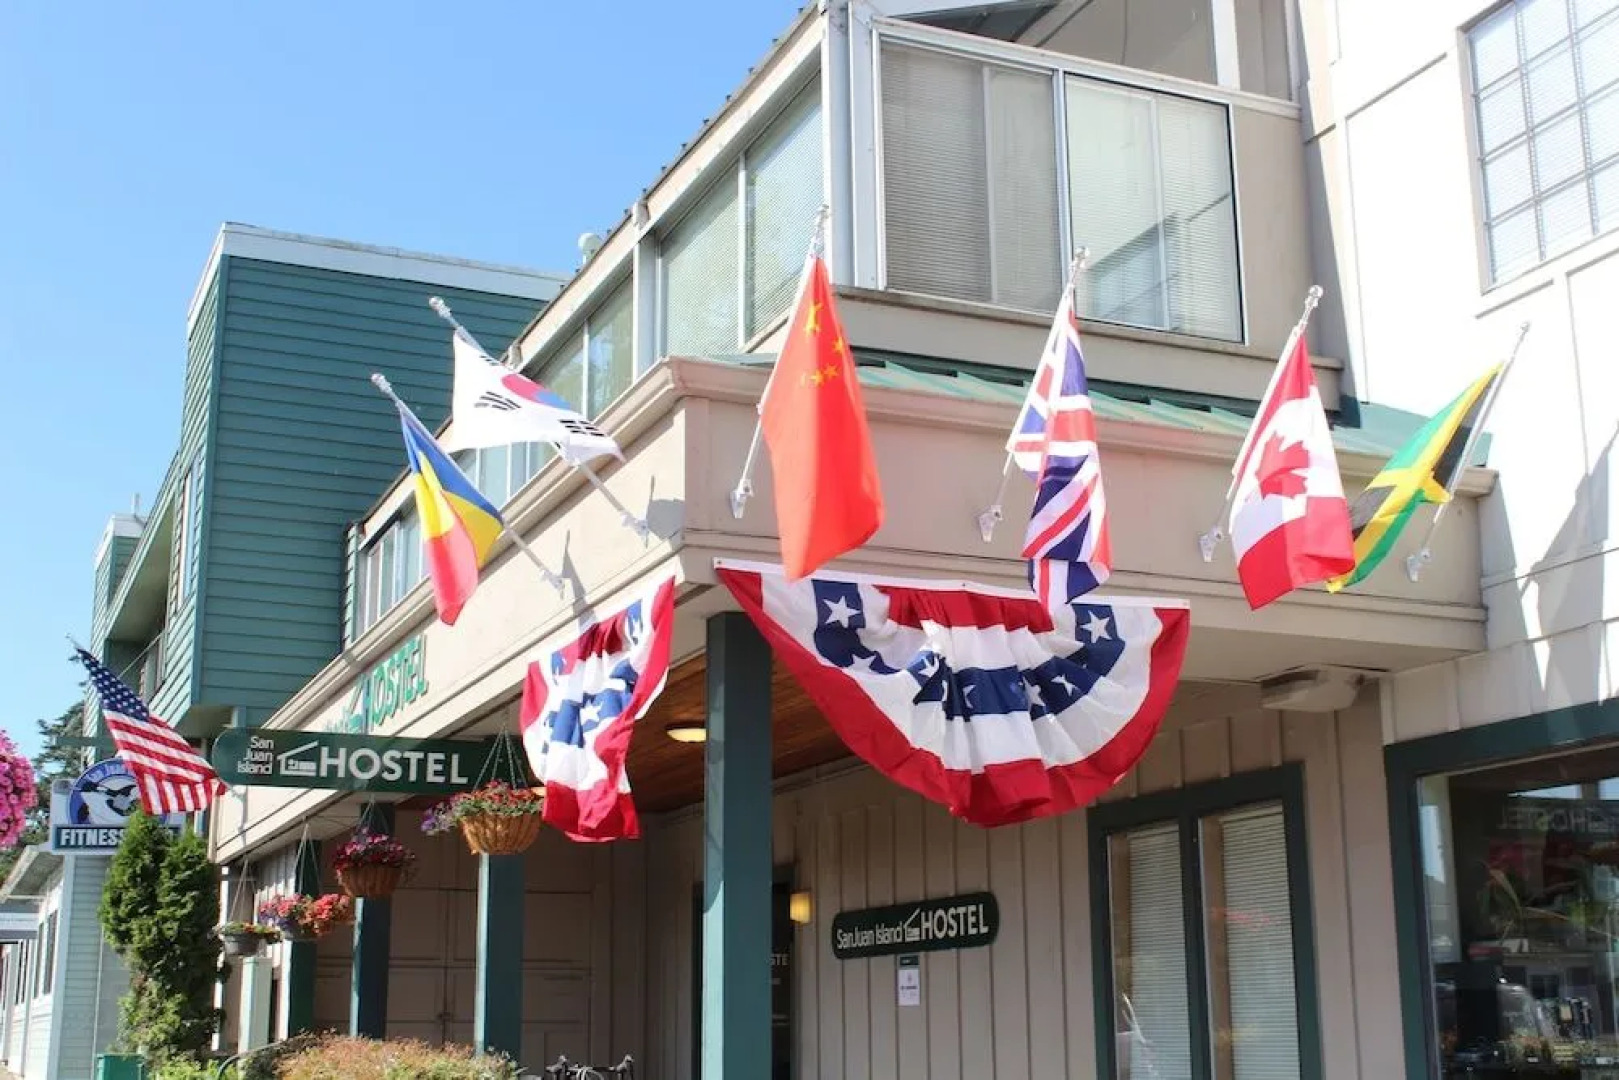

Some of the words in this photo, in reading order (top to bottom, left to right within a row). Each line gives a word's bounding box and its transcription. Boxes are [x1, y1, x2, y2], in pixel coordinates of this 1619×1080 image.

[362, 635, 428, 735] HOSTEL
[243, 748, 273, 762] Juan
[250, 736, 275, 749] San
[237, 760, 273, 775] Island
[319, 746, 469, 784] HOSTEL
[836, 928, 854, 949] San
[852, 925, 875, 948] Juan
[875, 921, 904, 945] Island
[920, 903, 990, 940] HOSTEL
